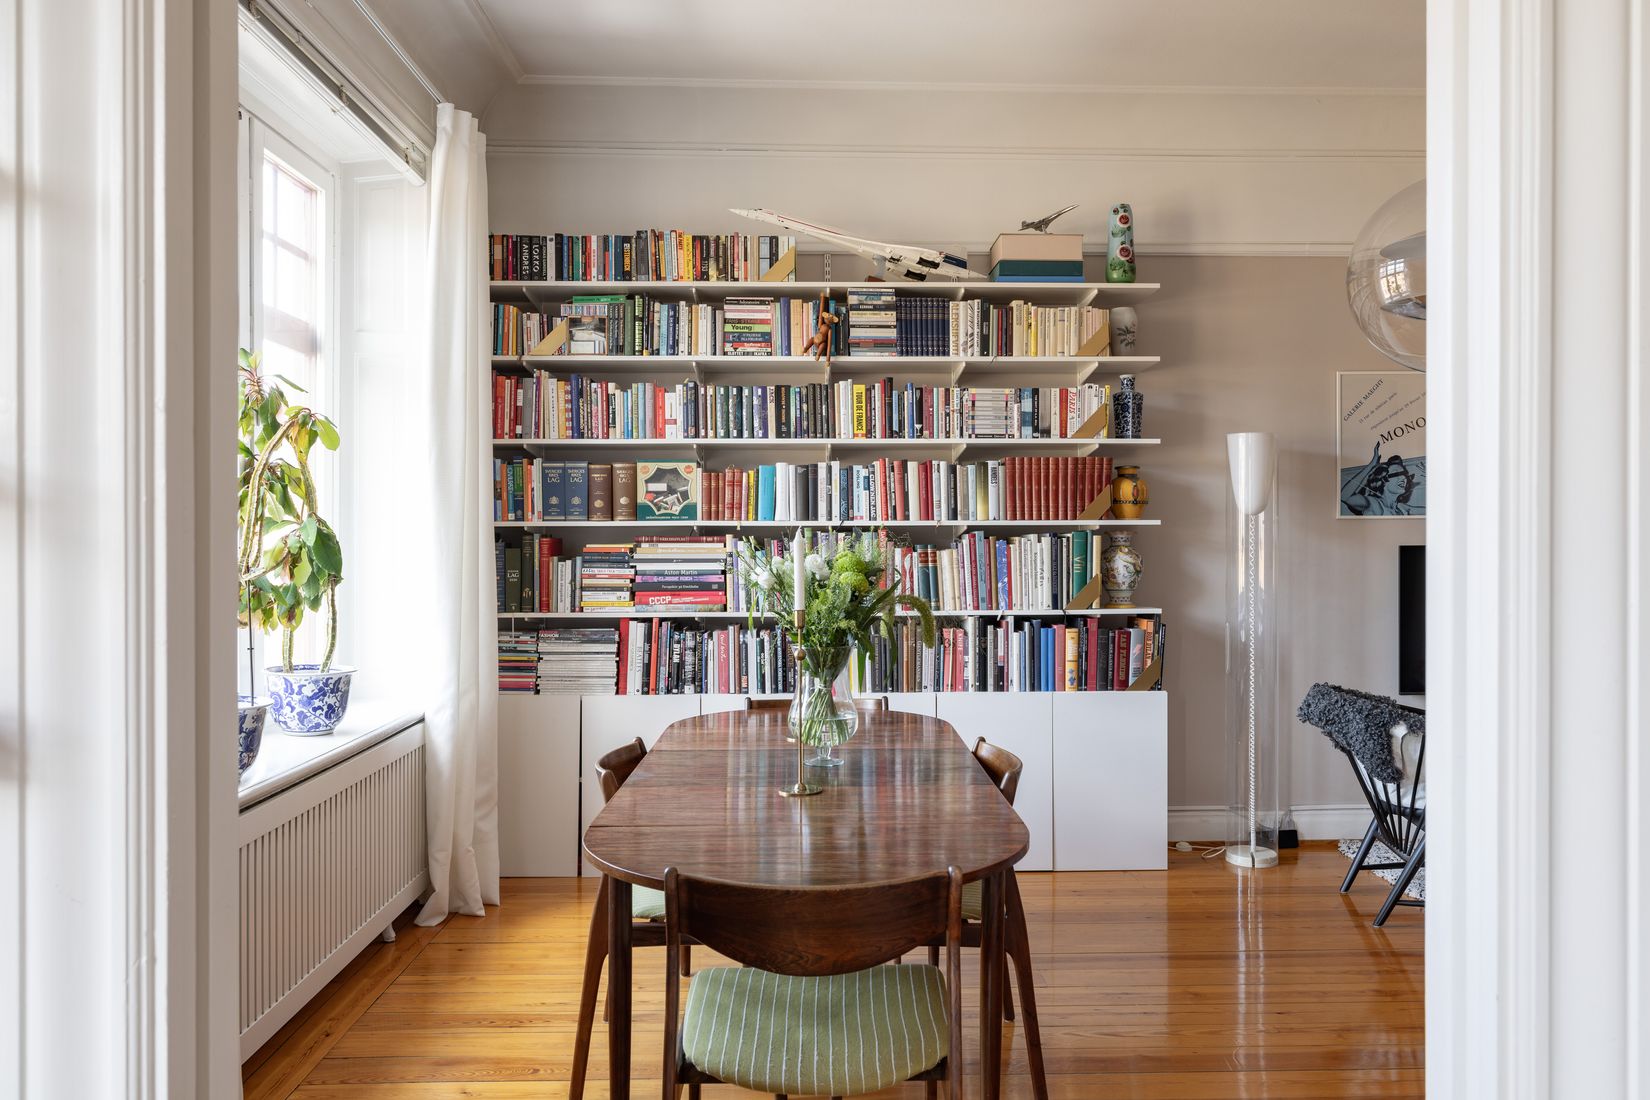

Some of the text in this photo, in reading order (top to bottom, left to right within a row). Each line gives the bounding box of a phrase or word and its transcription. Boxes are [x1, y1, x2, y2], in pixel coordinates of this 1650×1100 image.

[532, 244, 540, 273] LOKKO
[1069, 391, 1077, 414] PARIS
[1343, 400, 1364, 422] GALERIE
[1362, 378, 1384, 401] MAEGHT
[856, 412, 864, 431] FRANCE
[1380, 416, 1426, 444] MONO
[649, 596, 671, 605] CCCP
[673, 643, 681, 663] DYLAN
[1119, 649, 1127, 681] FLEMING
